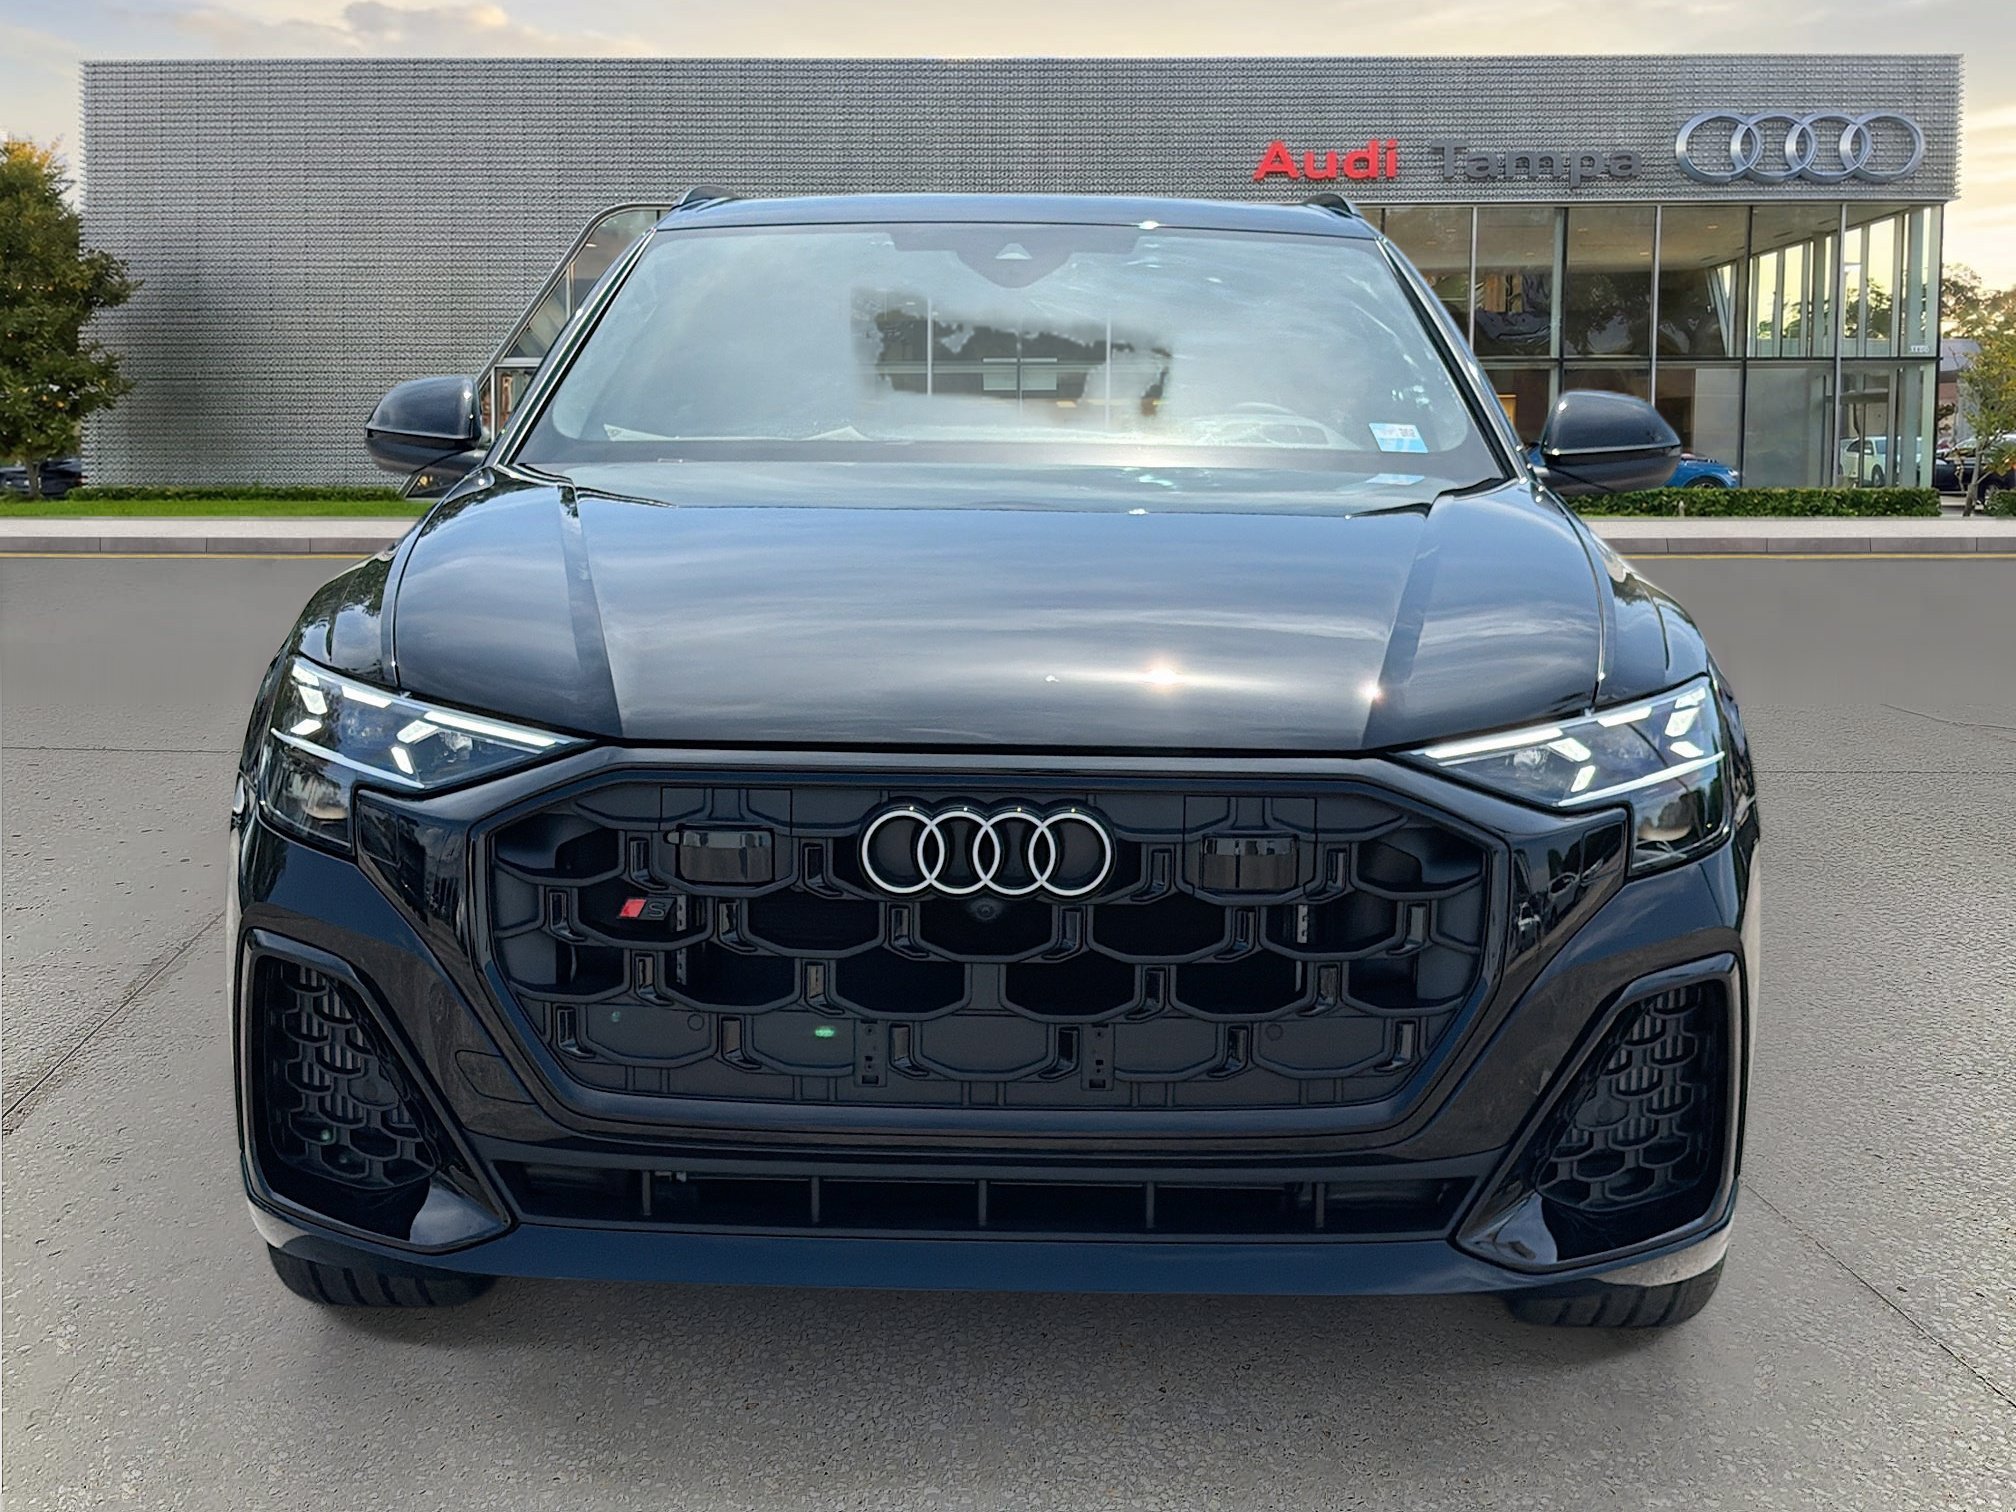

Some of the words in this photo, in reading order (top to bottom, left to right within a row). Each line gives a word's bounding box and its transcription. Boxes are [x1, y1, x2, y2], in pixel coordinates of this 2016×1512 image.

[1253, 139, 1398, 180] Audi
[1429, 139, 1642, 190] Tampa
[648, 902, 665, 917] S
